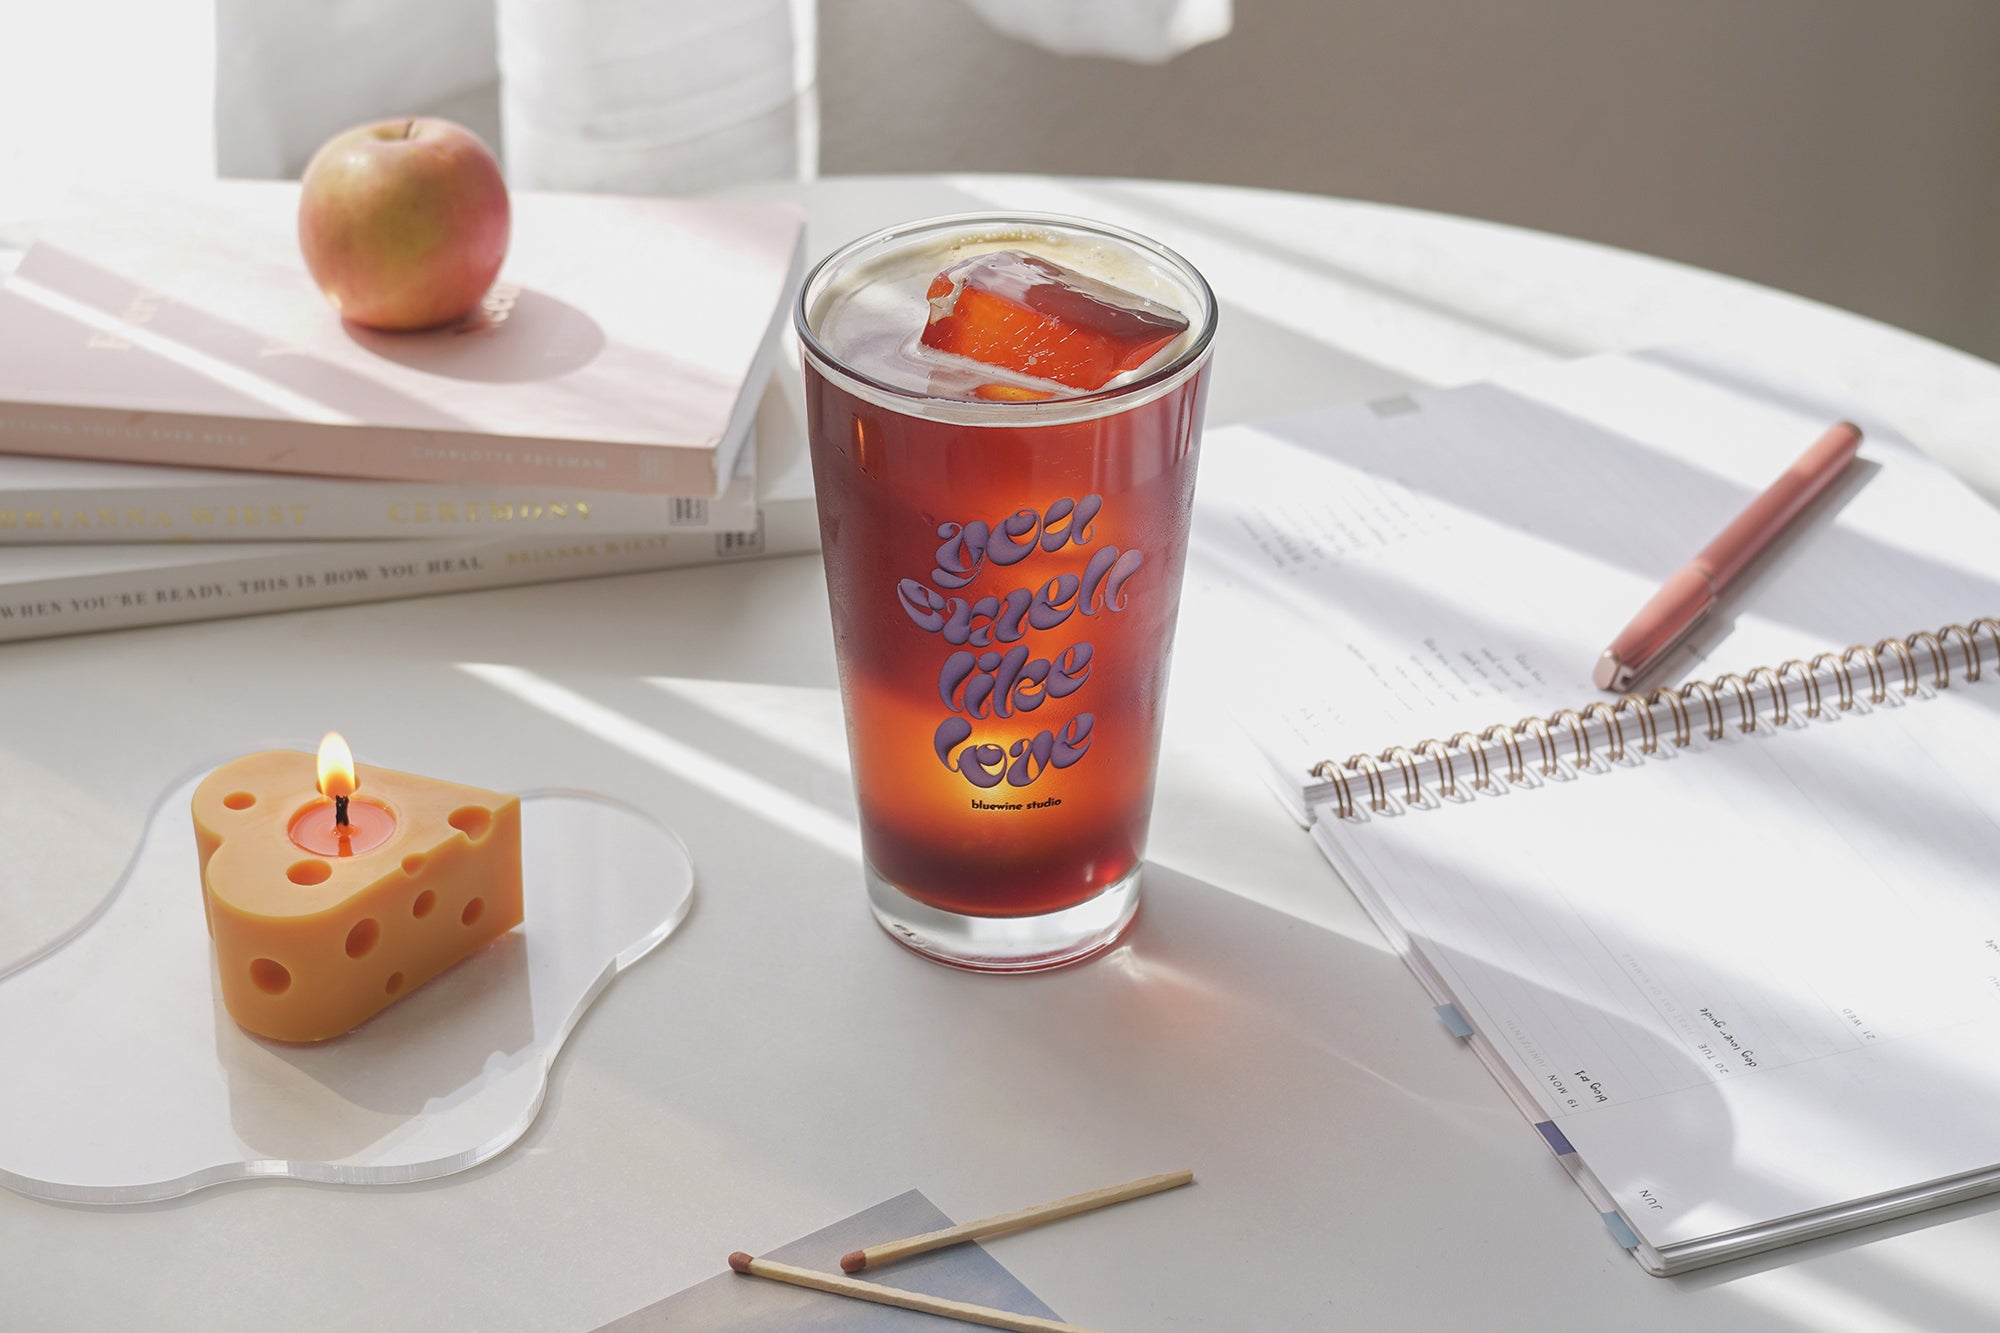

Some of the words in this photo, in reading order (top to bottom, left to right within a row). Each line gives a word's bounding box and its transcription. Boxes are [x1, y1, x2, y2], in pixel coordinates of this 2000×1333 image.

[151, 429, 193, 442] EVER
[203, 433, 248, 446] NEED
[189, 504, 310, 526] WIEST
[389, 500, 592, 523] CEREMONY
[931, 494, 1102, 589] you
[507, 546, 597, 567] BRIANNA
[0, 601, 62, 620] WHEN
[71, 592, 148, 612] YOU'RE
[238, 577, 289, 595] THIS
[297, 574, 317, 588] IS
[324, 566, 369, 586] HOW
[379, 560, 419, 579] YOU
[427, 555, 484, 573] HEAL
[897, 545, 1144, 648] smell
[938, 642, 1094, 720] like
[933, 712, 1095, 788] love
[971, 799, 1023, 811] bluewine
[1026, 797, 1062, 811] studio
[1699, 1007, 1727, 1029] guide
[1842, 1007, 1862, 1027] WED
[1719, 1030, 1741, 1051] lover
[1863, 1030, 1876, 1041] 21
[1697, 1043, 1717, 1060] TUE
[1741, 1049, 1758, 1068] dog
[1714, 1062, 1729, 1074] 20
[1548, 1073, 1568, 1094] MON
[1589, 1081, 1608, 1103] blog
[1567, 1098, 1579, 1109] 19
[1639, 1189, 1664, 1210] JUN
